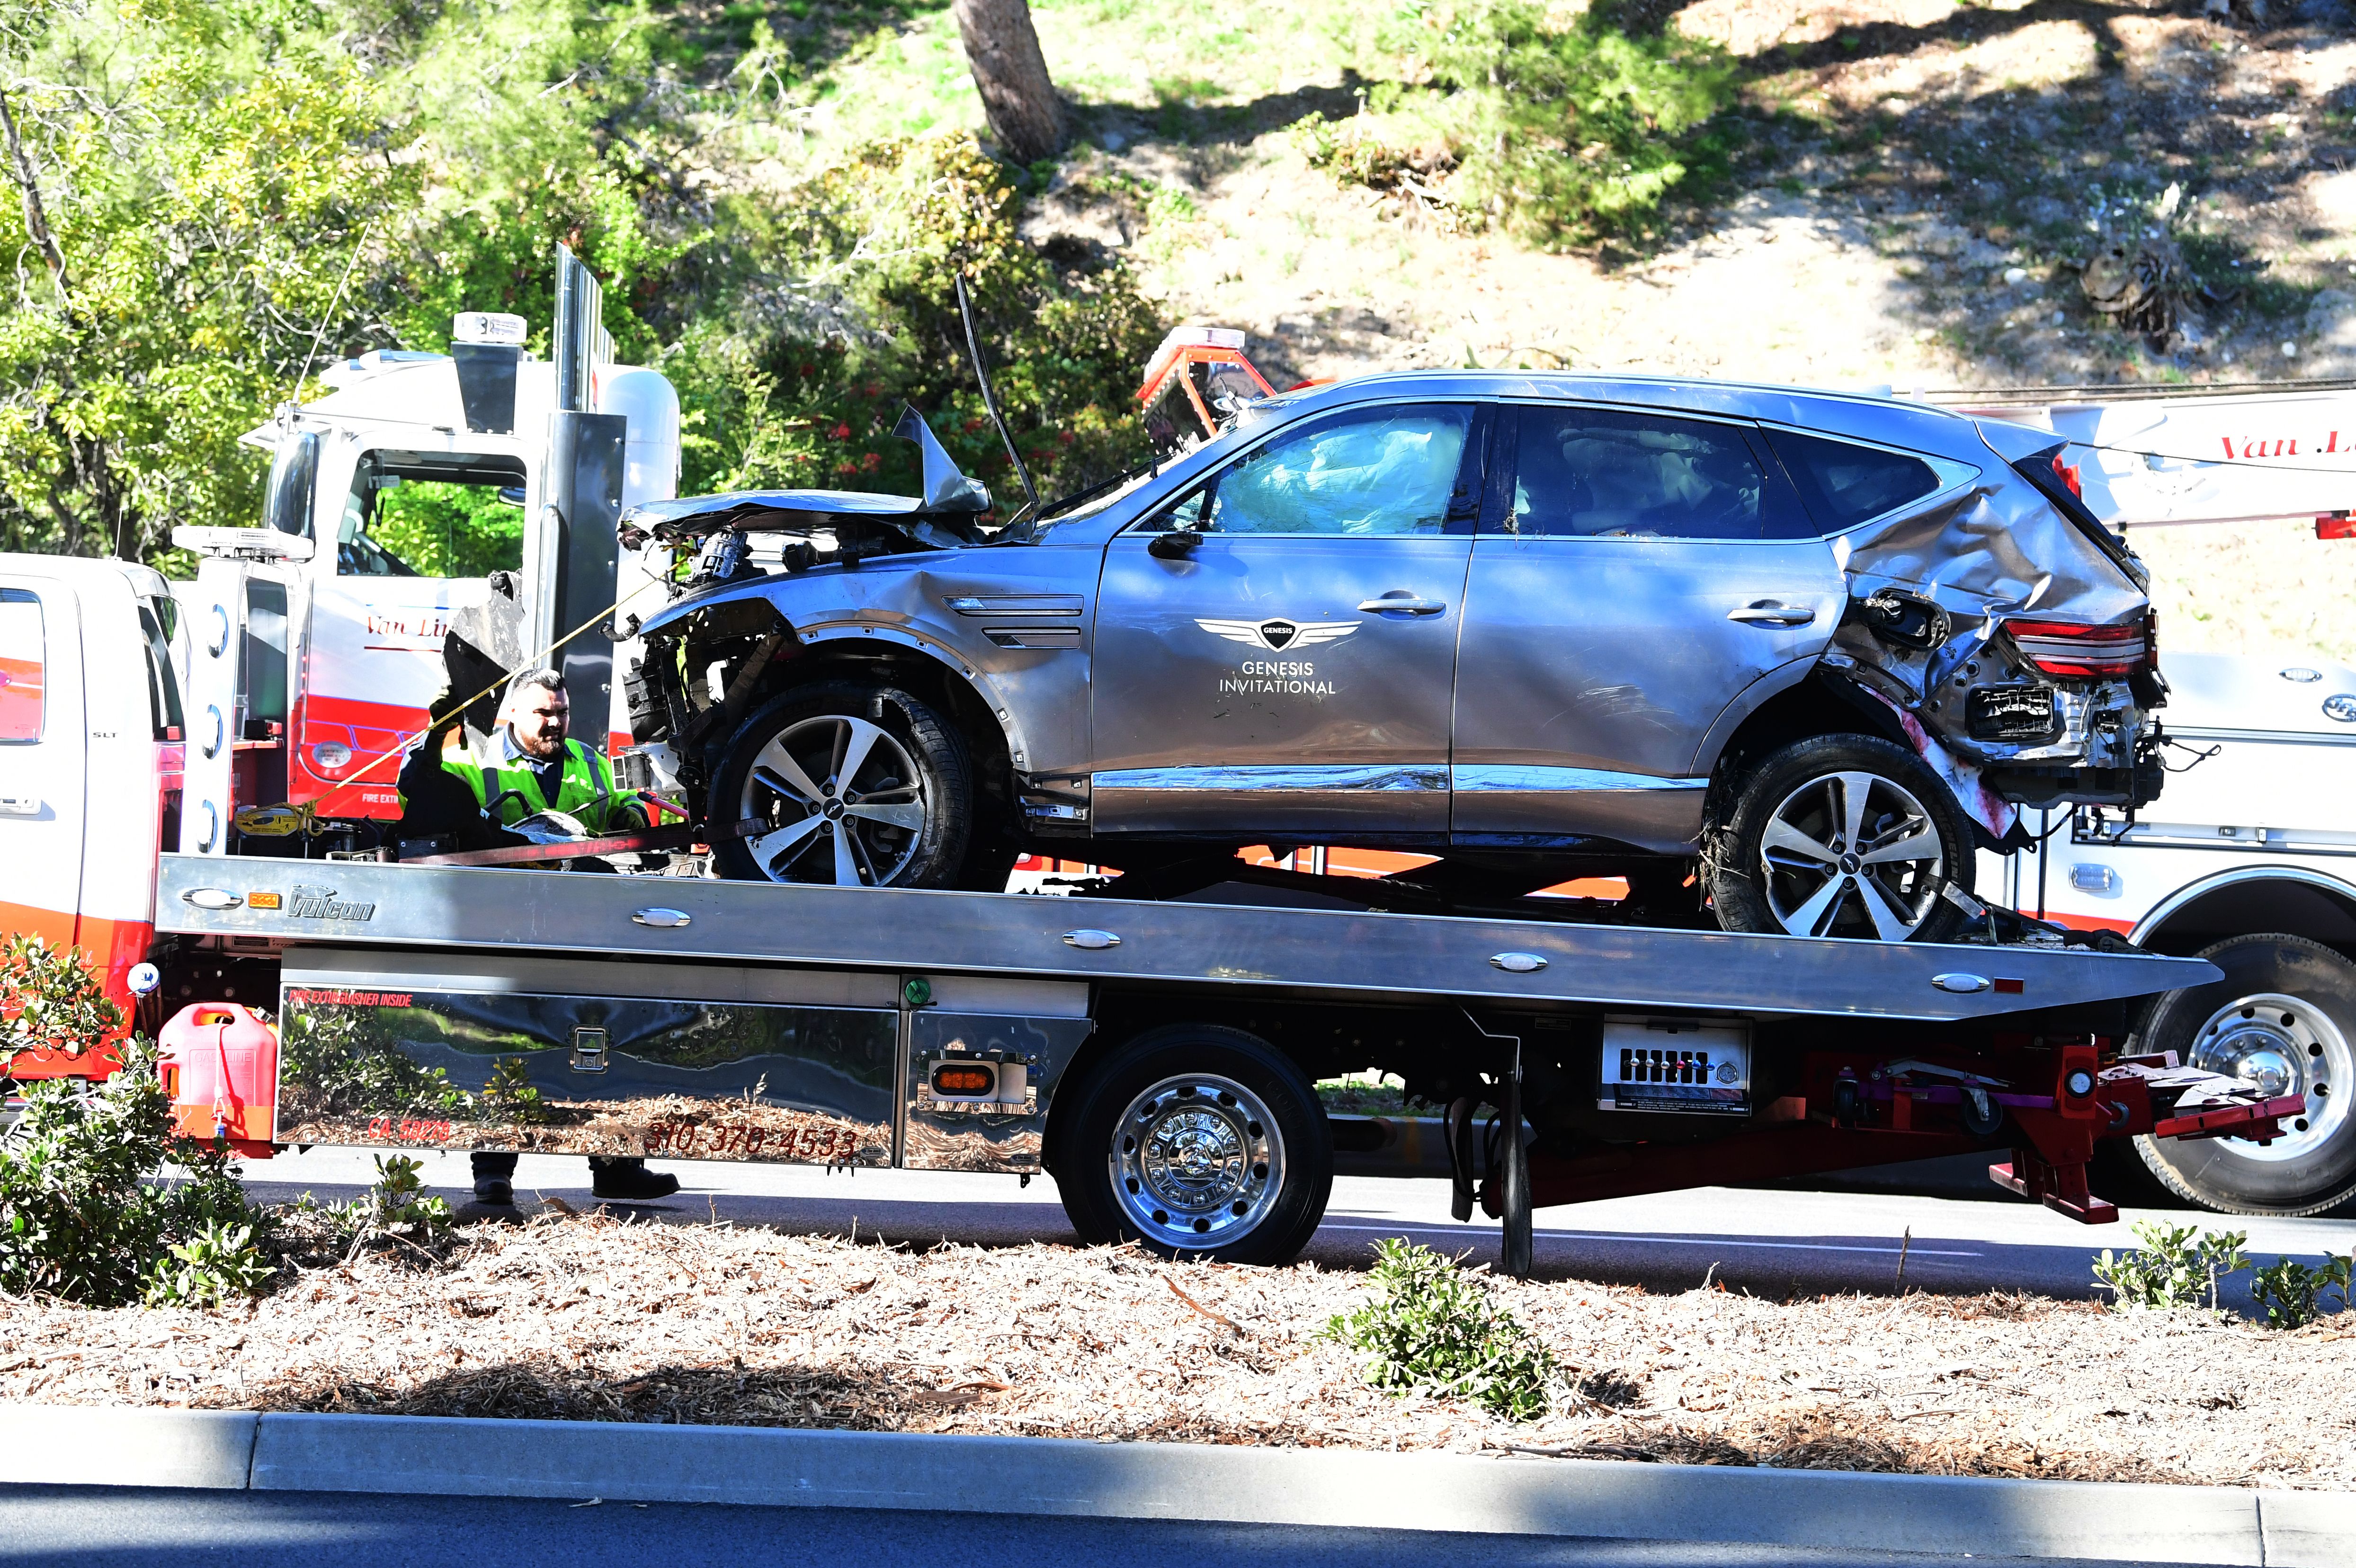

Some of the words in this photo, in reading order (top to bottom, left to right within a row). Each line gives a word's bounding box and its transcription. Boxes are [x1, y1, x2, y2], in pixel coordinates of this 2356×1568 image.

[2222, 436, 2301, 459] Van
[367, 615, 407, 635] Van
[1242, 661, 1313, 676] GENESIS
[1220, 679, 1336, 695] INVITATIONAL
[362, 793, 379, 803] FIRE
[286, 890, 376, 921] Vulcan
[288, 989, 311, 1003] FIRE
[311, 990, 379, 1006] EXTINGUISHER
[380, 993, 413, 1007] INSIDE
[194, 1052, 251, 1062] GASLINE
[368, 1118, 391, 1138] CA
[399, 1119, 450, 1140] 58278
[645, 1122, 858, 1158] 310-370-4533
